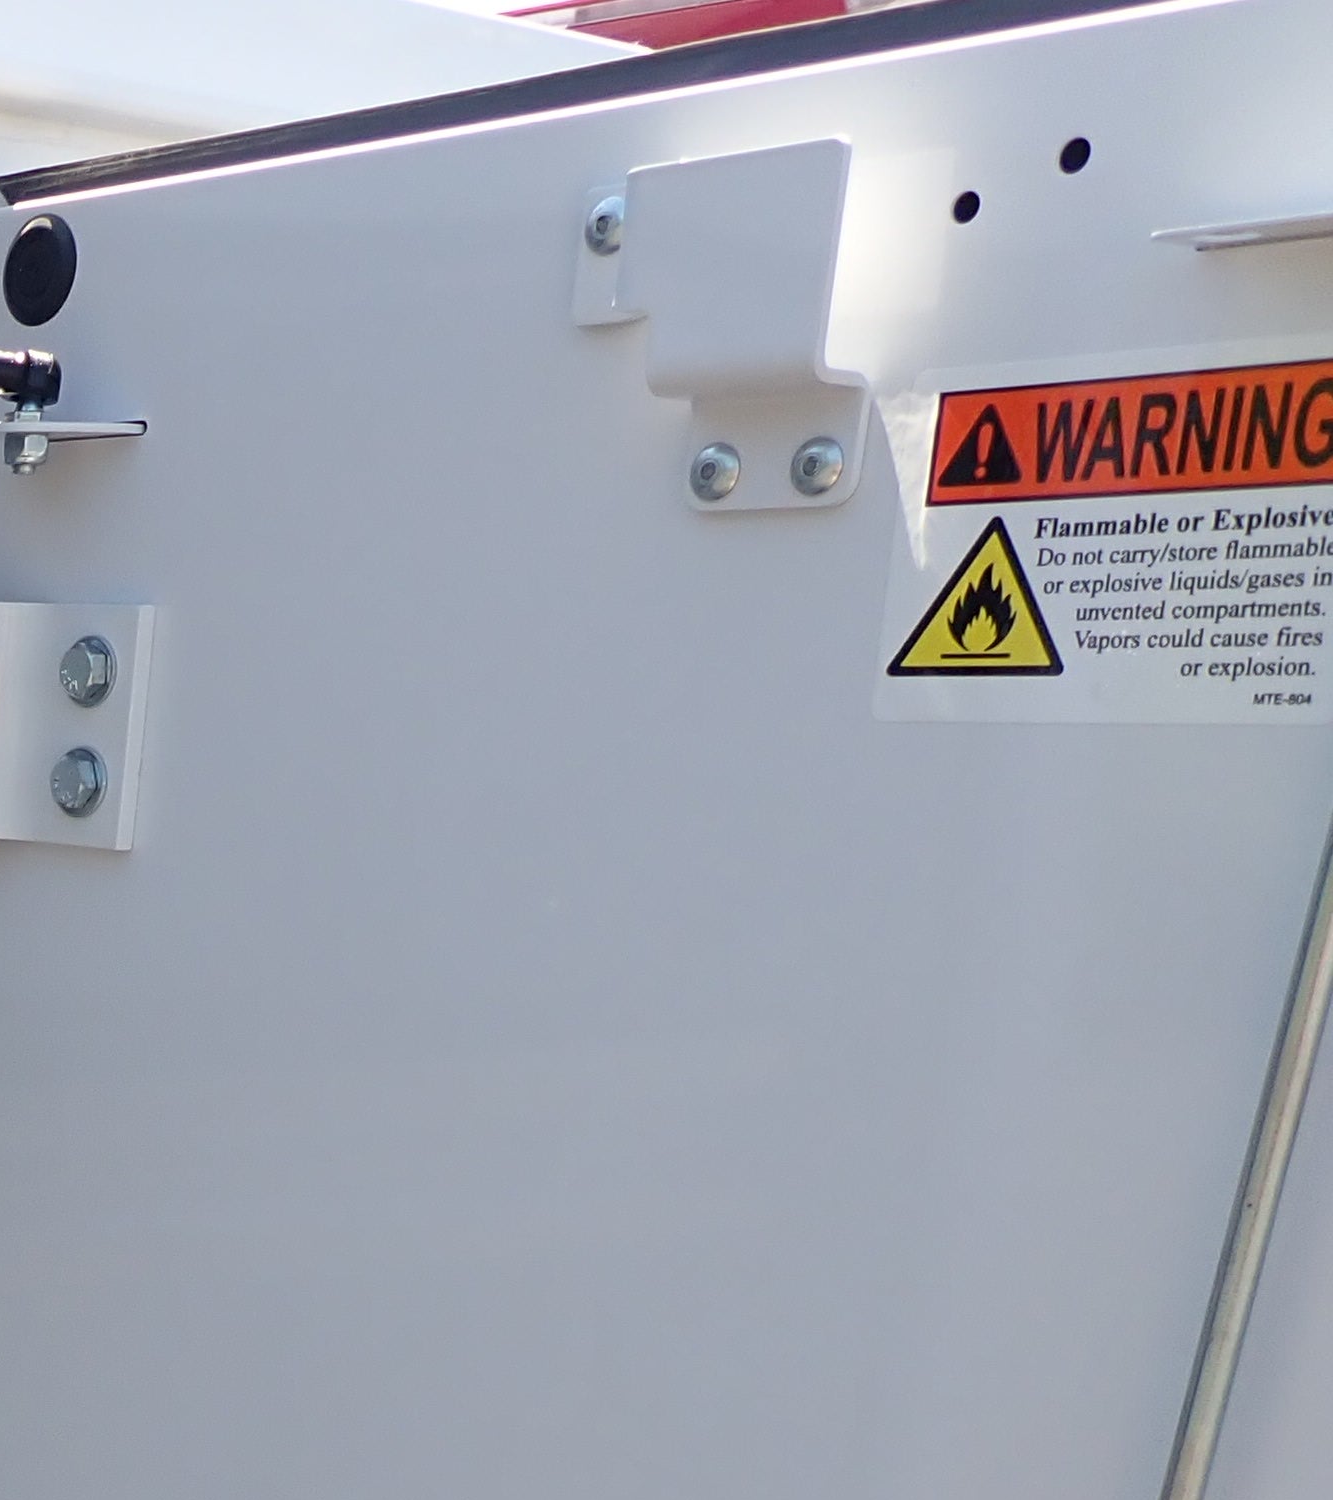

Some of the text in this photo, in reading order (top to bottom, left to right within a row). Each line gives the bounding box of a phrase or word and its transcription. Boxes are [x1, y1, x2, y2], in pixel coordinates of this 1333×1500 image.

[1036, 377, 1333, 484] WARNING
[1034, 505, 1333, 539] Flammable or Explosive
[1036, 536, 1333, 568] Do not carry/store flammable
[1043, 566, 1333, 598] or explosive liquids/gases in
[1076, 600, 1326, 624] unvented compartments.
[1075, 626, 1324, 654] Vapors could cause fires
[1180, 656, 1316, 681] or explosion.
